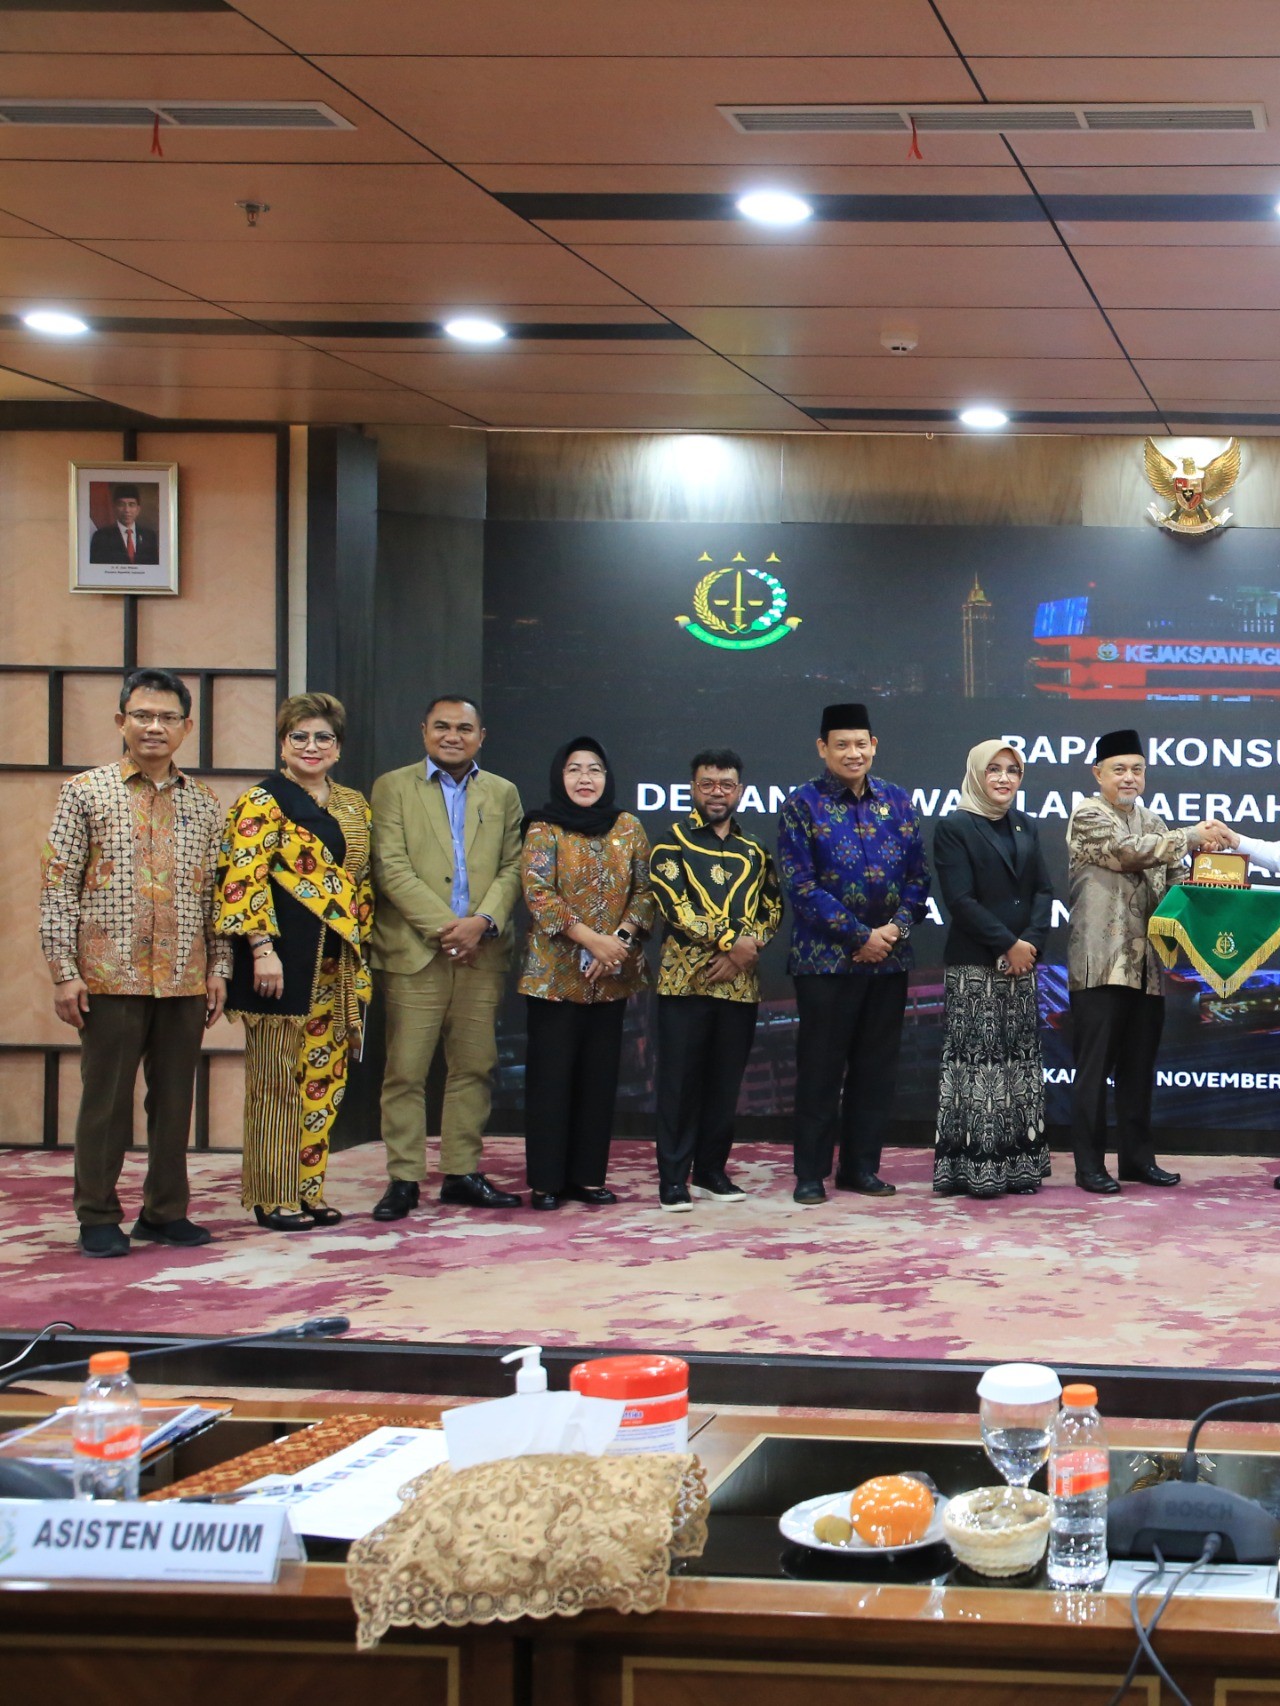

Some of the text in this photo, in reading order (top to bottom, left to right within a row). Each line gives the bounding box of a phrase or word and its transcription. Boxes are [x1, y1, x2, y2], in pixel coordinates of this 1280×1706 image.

[1126, 645, 1243, 664] KEJAKSAAN
[637, 783, 797, 814] DEAN
[34, 1519, 264, 1553] ASISTEN UMUM
